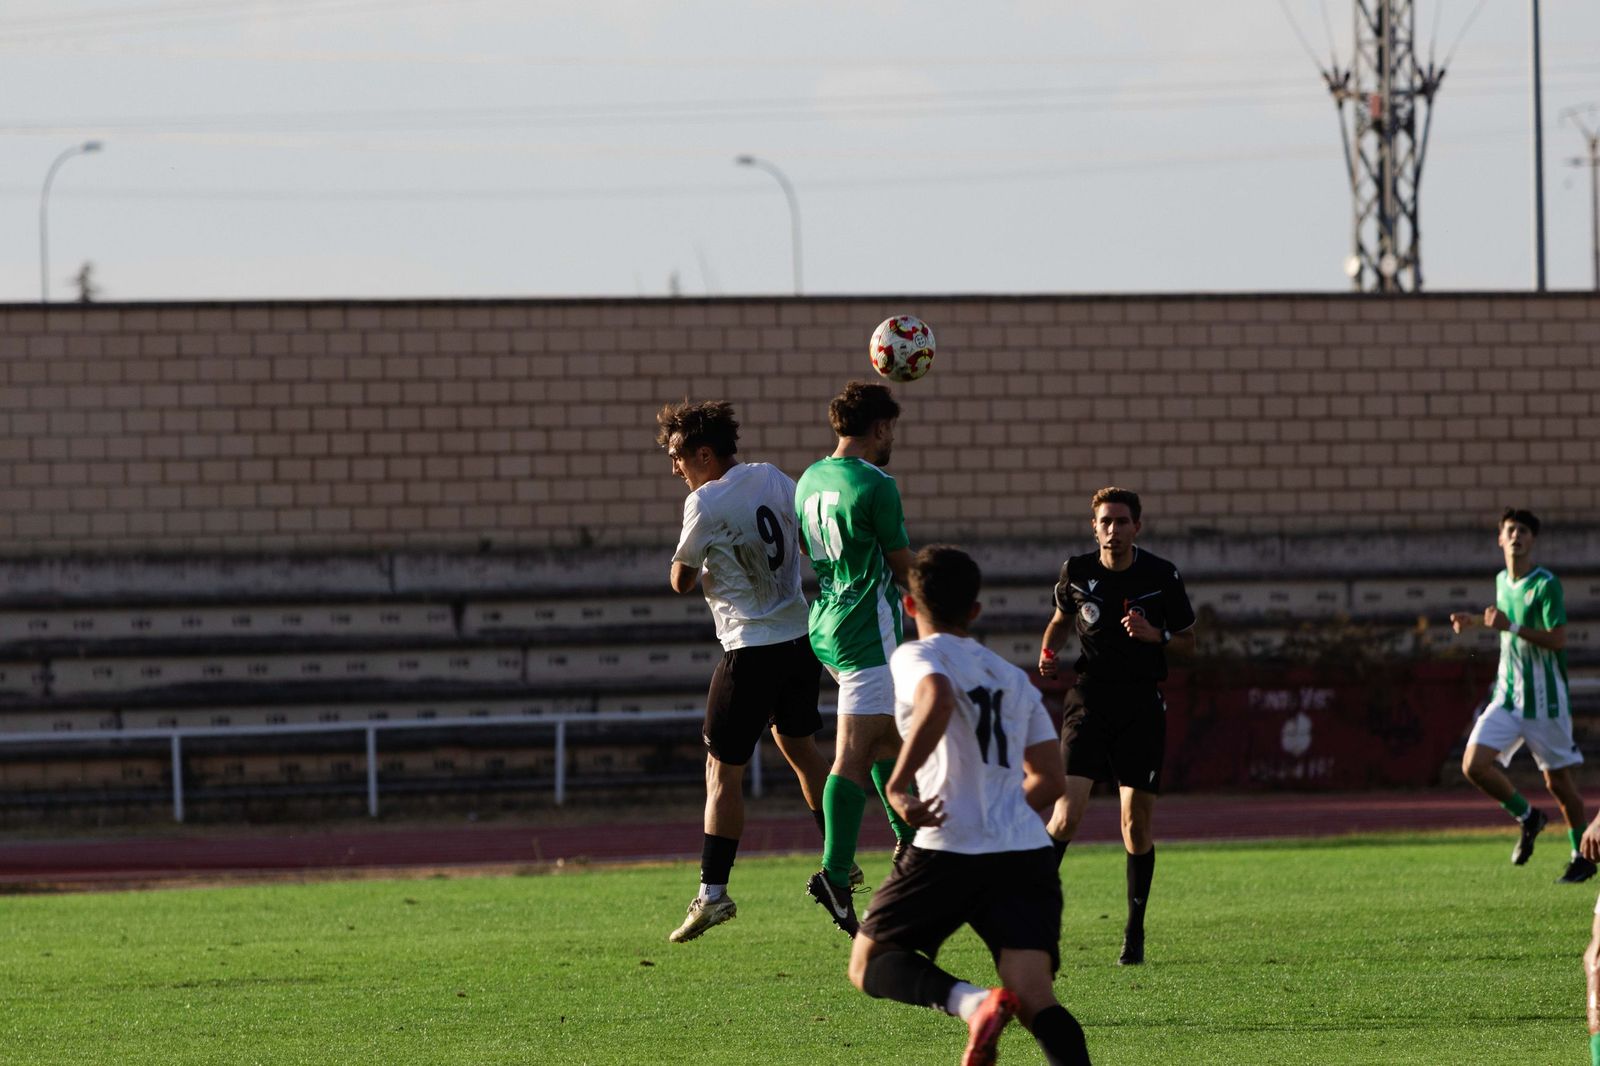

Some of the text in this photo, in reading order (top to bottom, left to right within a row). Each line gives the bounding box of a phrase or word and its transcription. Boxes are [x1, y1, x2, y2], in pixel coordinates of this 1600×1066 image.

[756, 505, 785, 572] 9
[804, 490, 844, 562] 15
[966, 685, 1011, 770] 11
